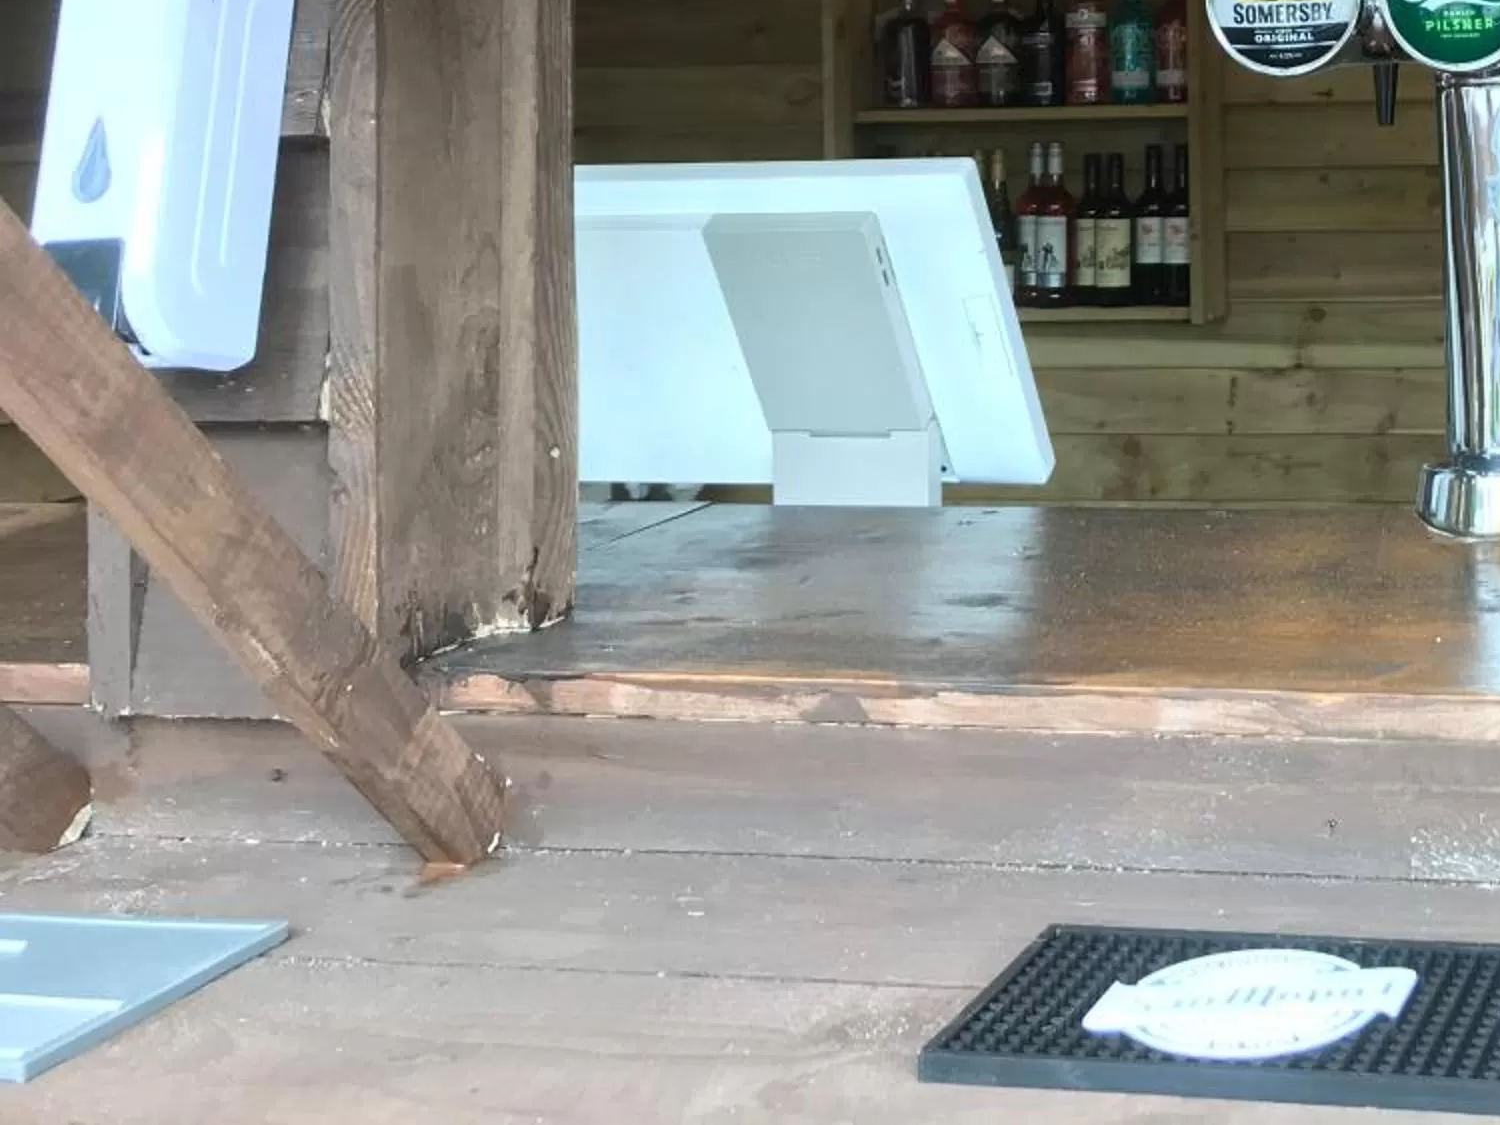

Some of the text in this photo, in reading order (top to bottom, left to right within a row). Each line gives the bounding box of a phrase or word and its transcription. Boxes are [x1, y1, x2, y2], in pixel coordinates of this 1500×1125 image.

[1233, 1, 1334, 25] SOMERSBY
[1424, 17, 1494, 32] PILSNER
[1254, 31, 1314, 43] ORIGINAL
